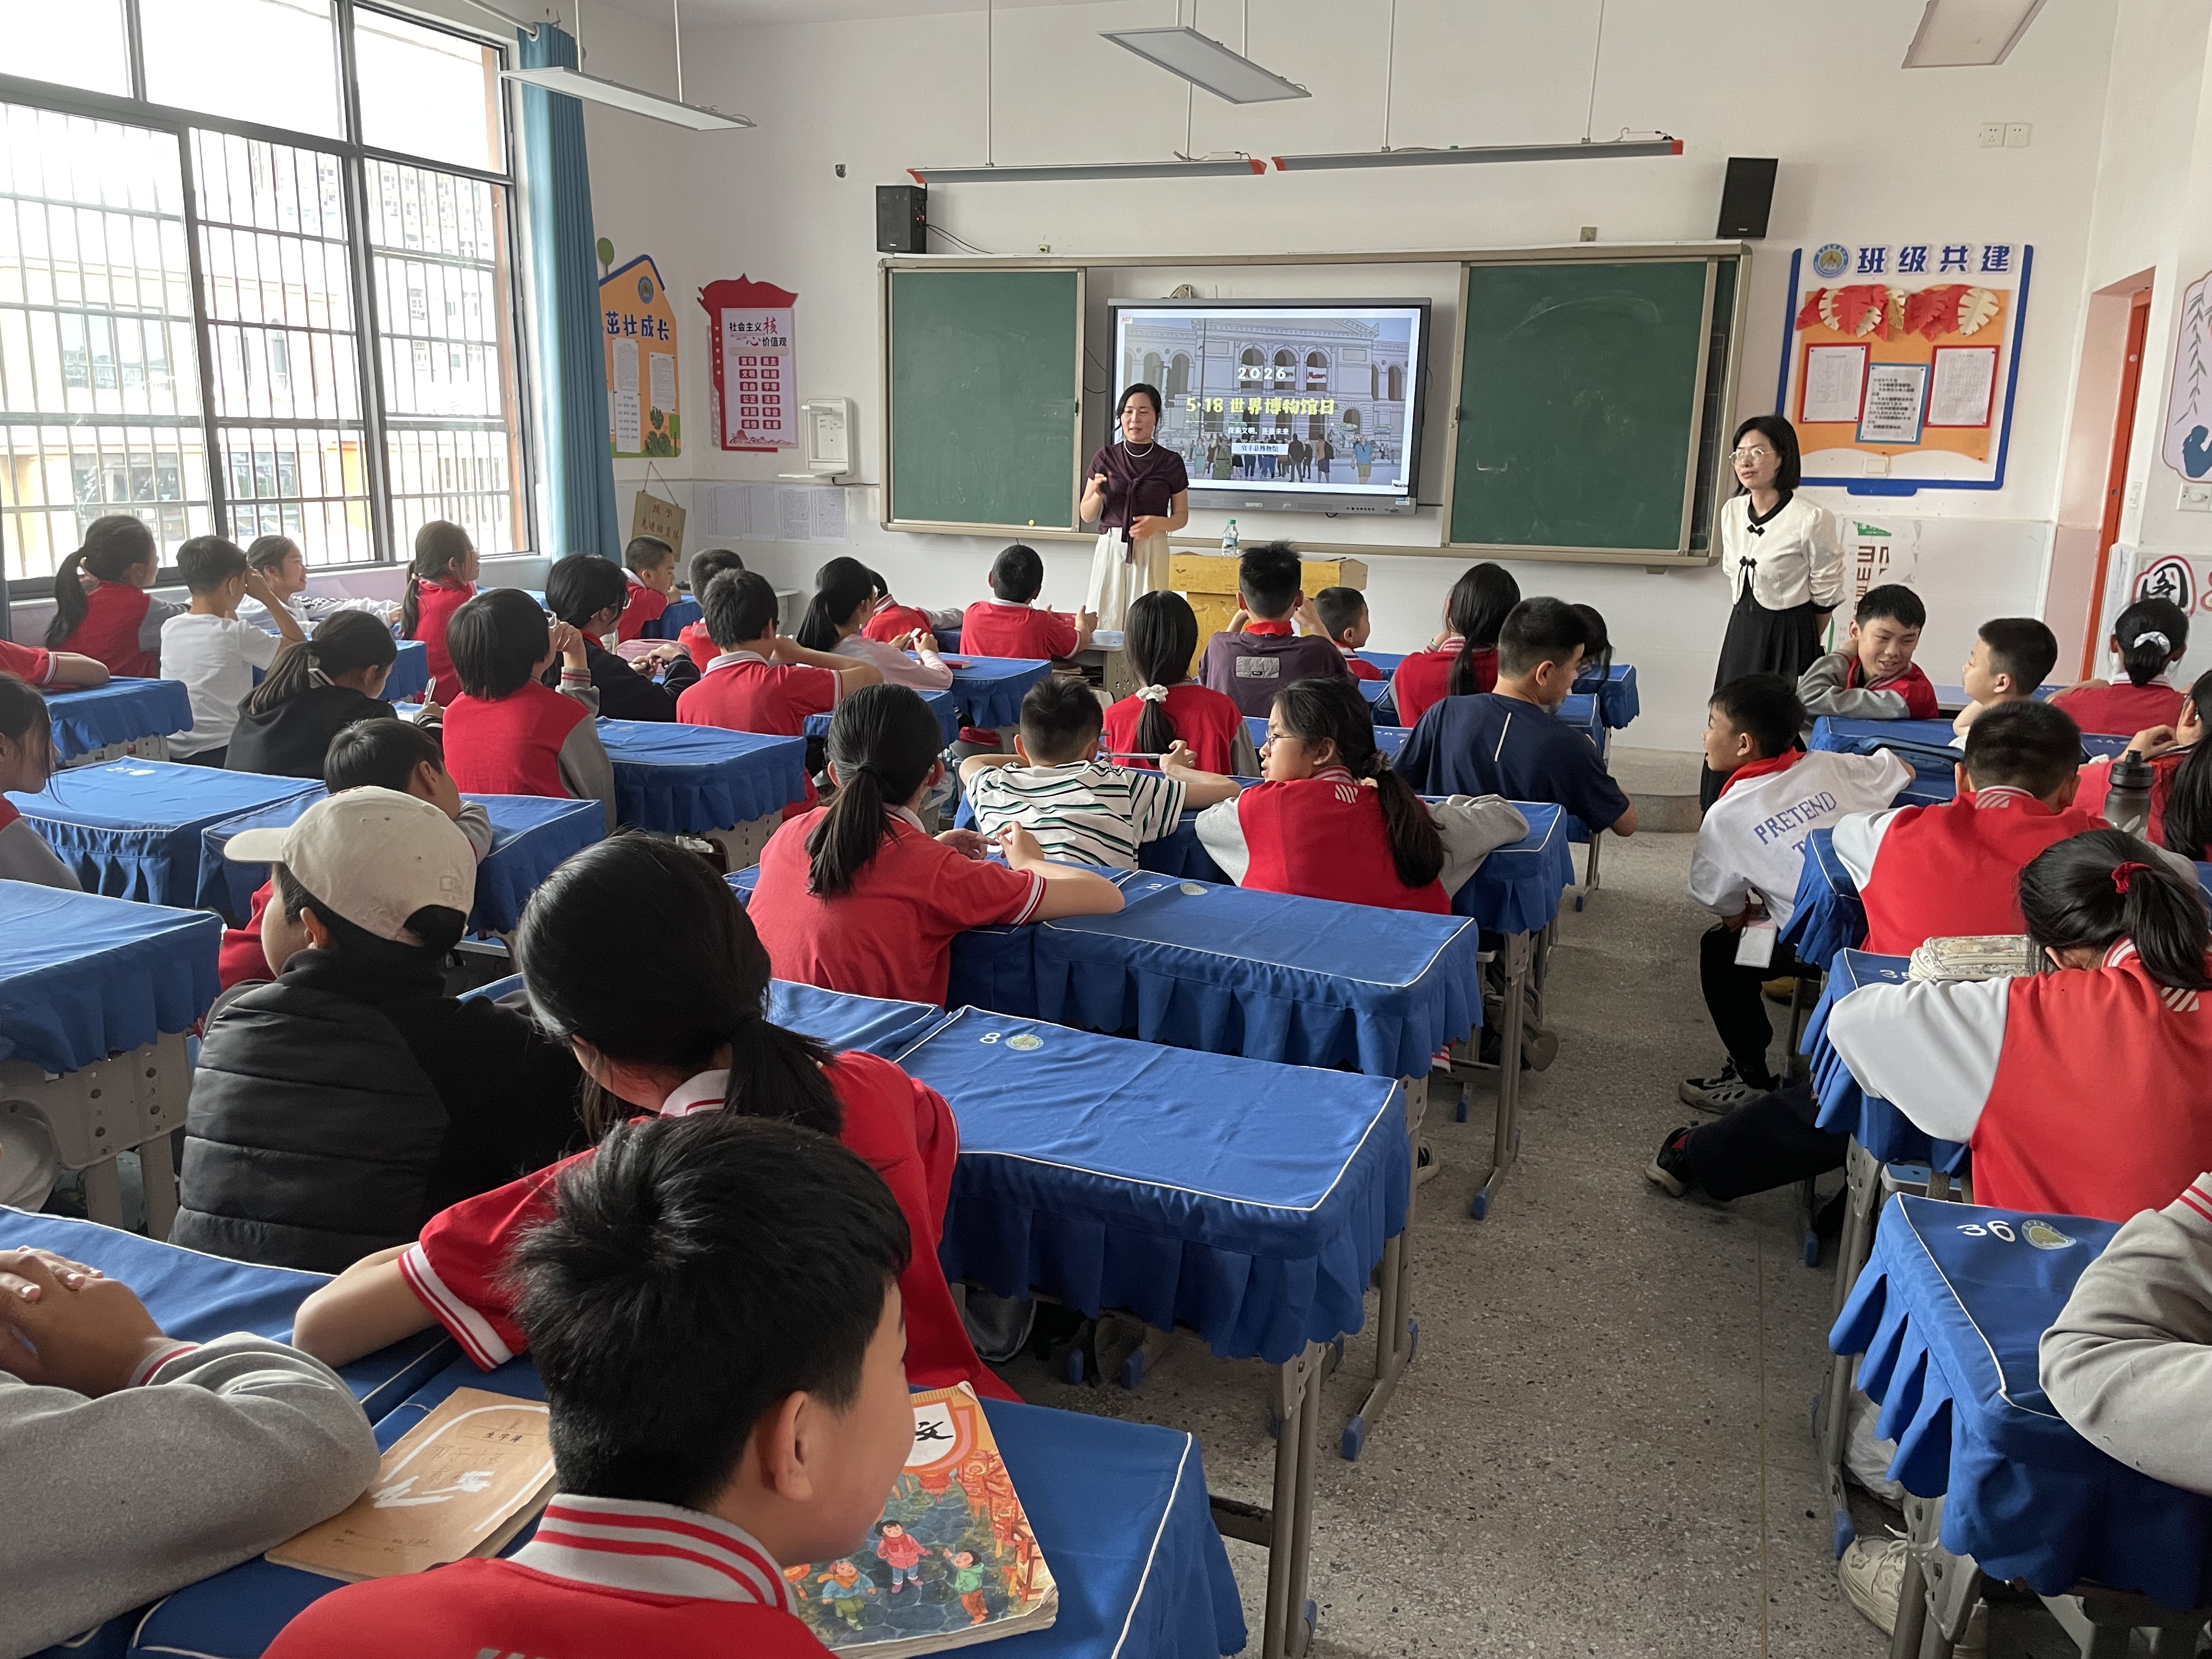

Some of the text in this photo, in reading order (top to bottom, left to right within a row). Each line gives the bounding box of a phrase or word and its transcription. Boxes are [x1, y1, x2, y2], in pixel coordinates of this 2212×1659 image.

[1857, 245, 2010, 273] 班级共建
[605, 311, 670, 341] 茁壮成长
[729, 317, 778, 334] 社会主义核
[746, 336, 787, 347] 心价值观
[1237, 367, 1286, 380] 2026
[1230, 397, 1335, 415] 世界博物馆日
[1753, 791, 1837, 845] PRETEND
[979, 1032, 1001, 1044] 8
[1956, 1220, 2016, 1243] 36
[915, 1421, 954, 1442] 文
